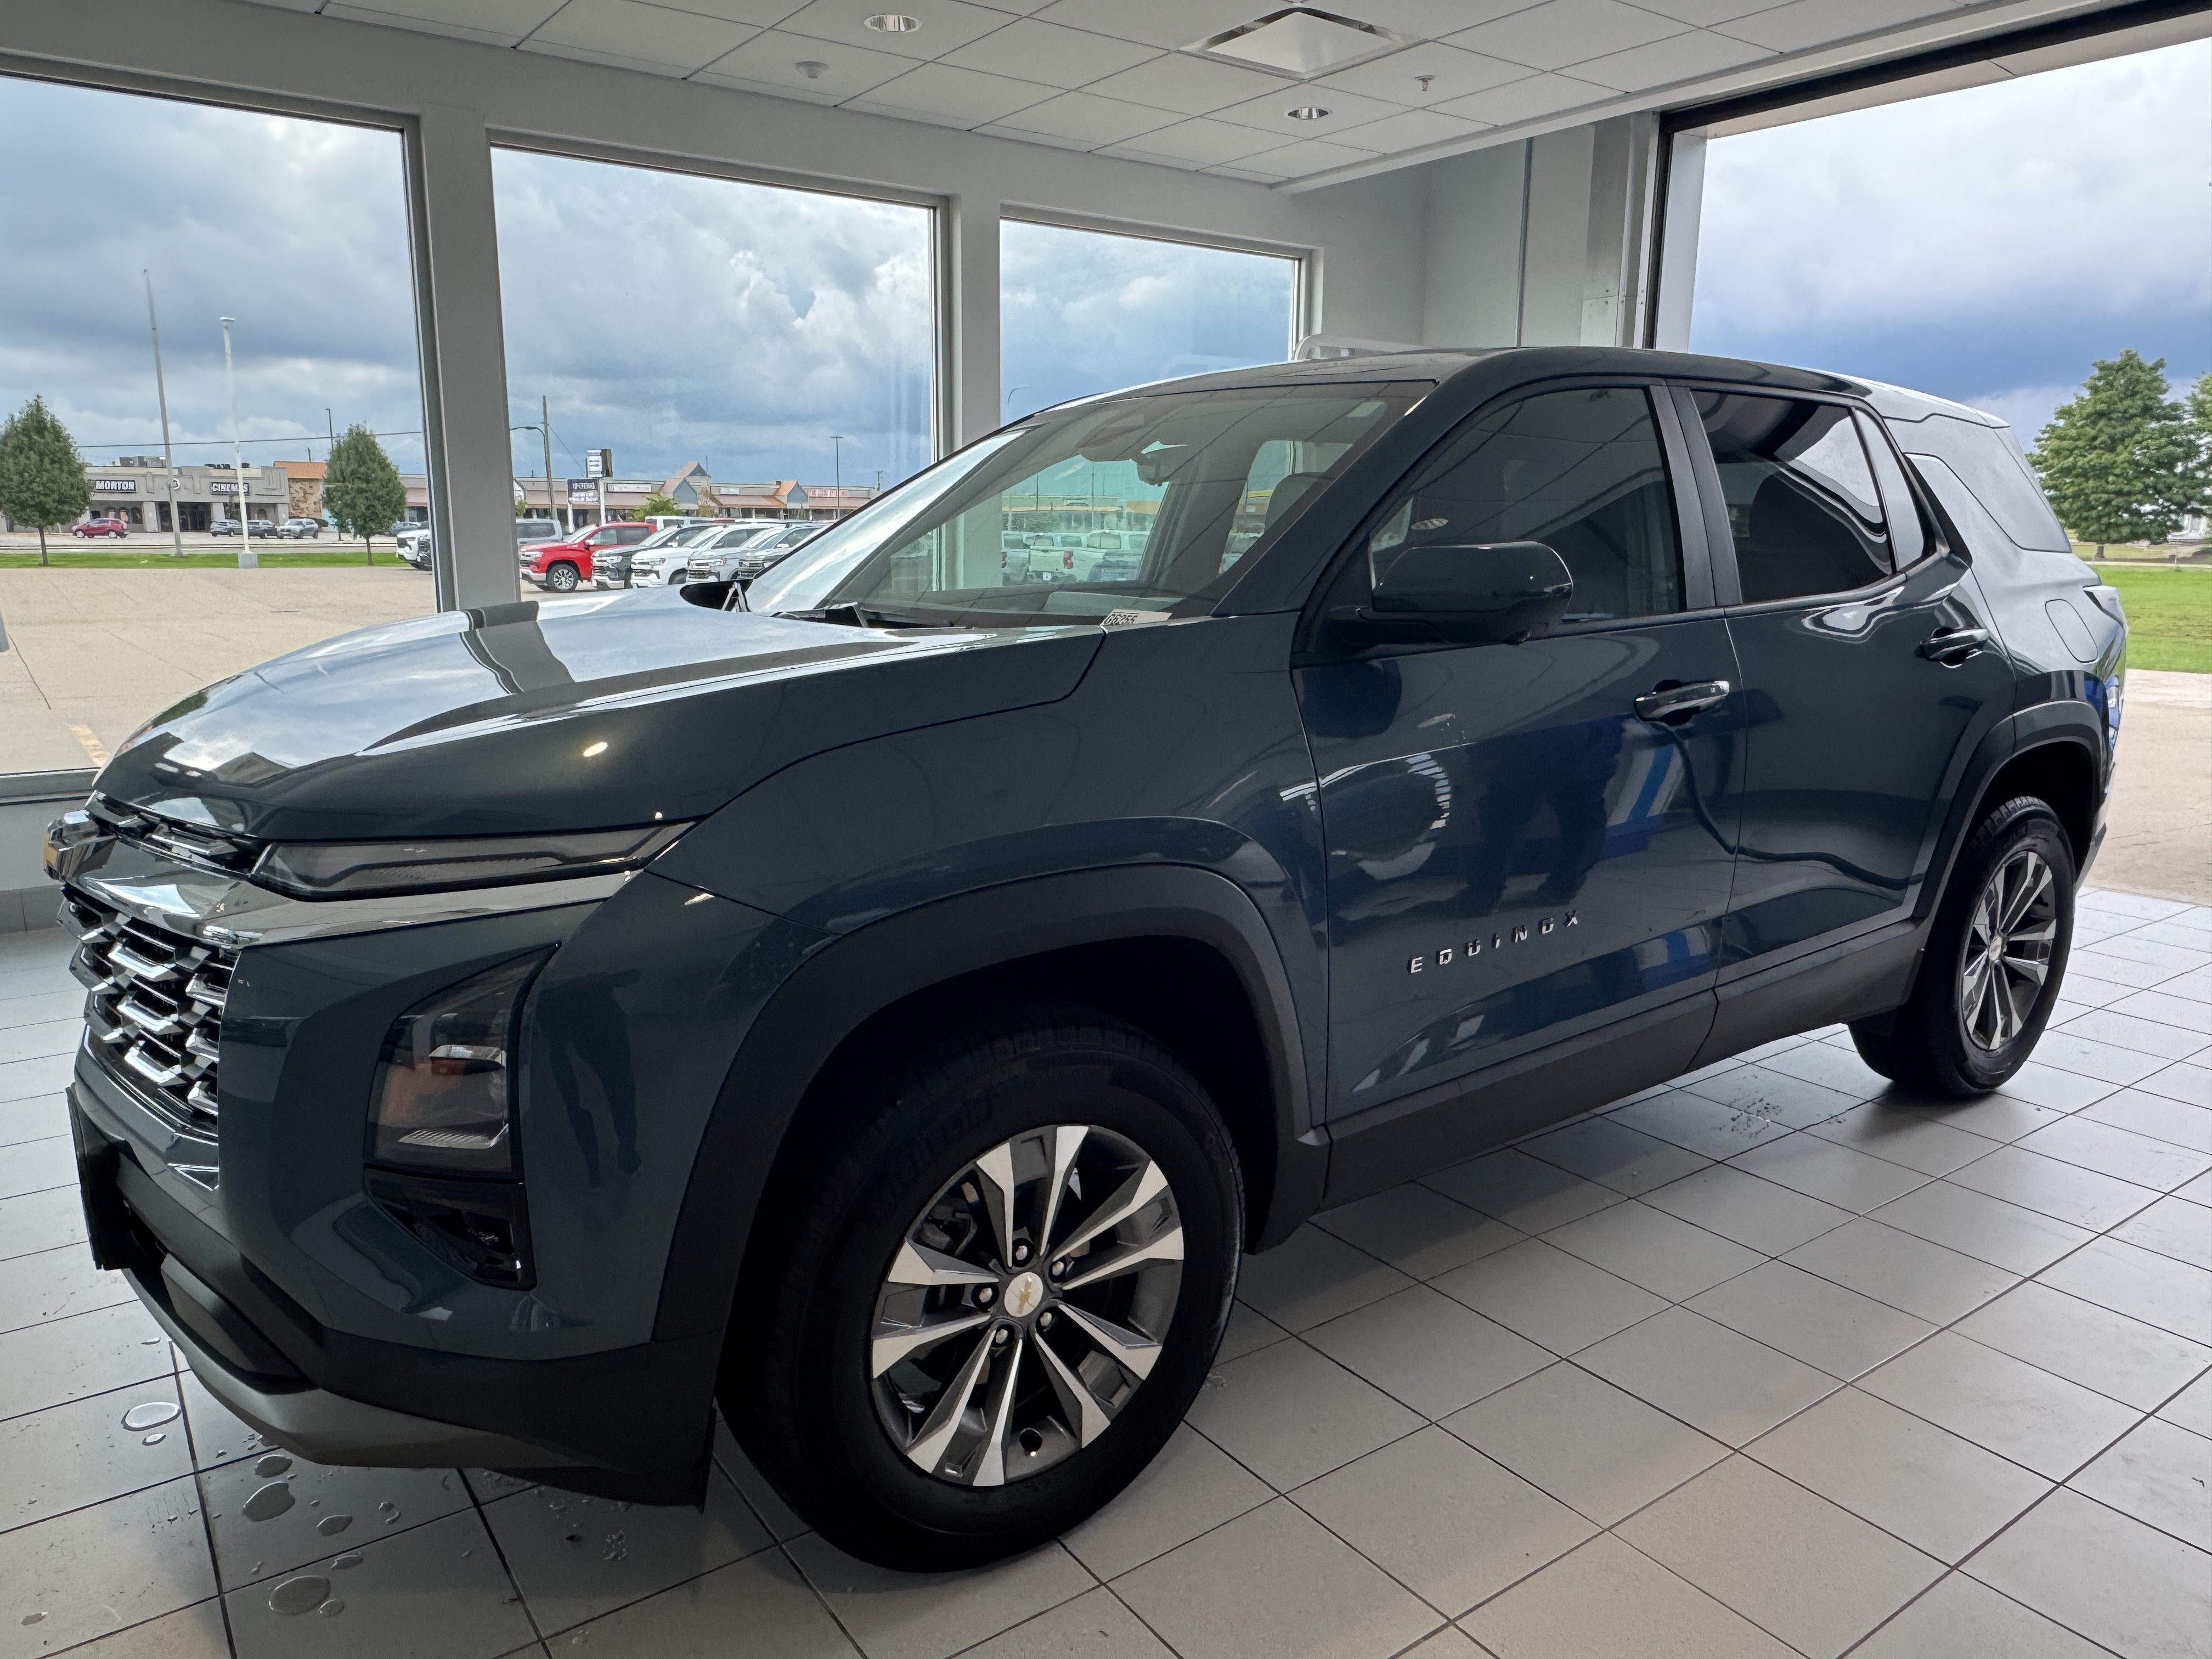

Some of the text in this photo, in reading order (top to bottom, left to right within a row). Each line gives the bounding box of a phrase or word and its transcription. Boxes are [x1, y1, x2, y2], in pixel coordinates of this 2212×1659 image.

[95, 481, 135, 490] MORTON
[212, 483, 248, 492] CINEMS
[1408, 910, 1579, 974] EQUINOX
